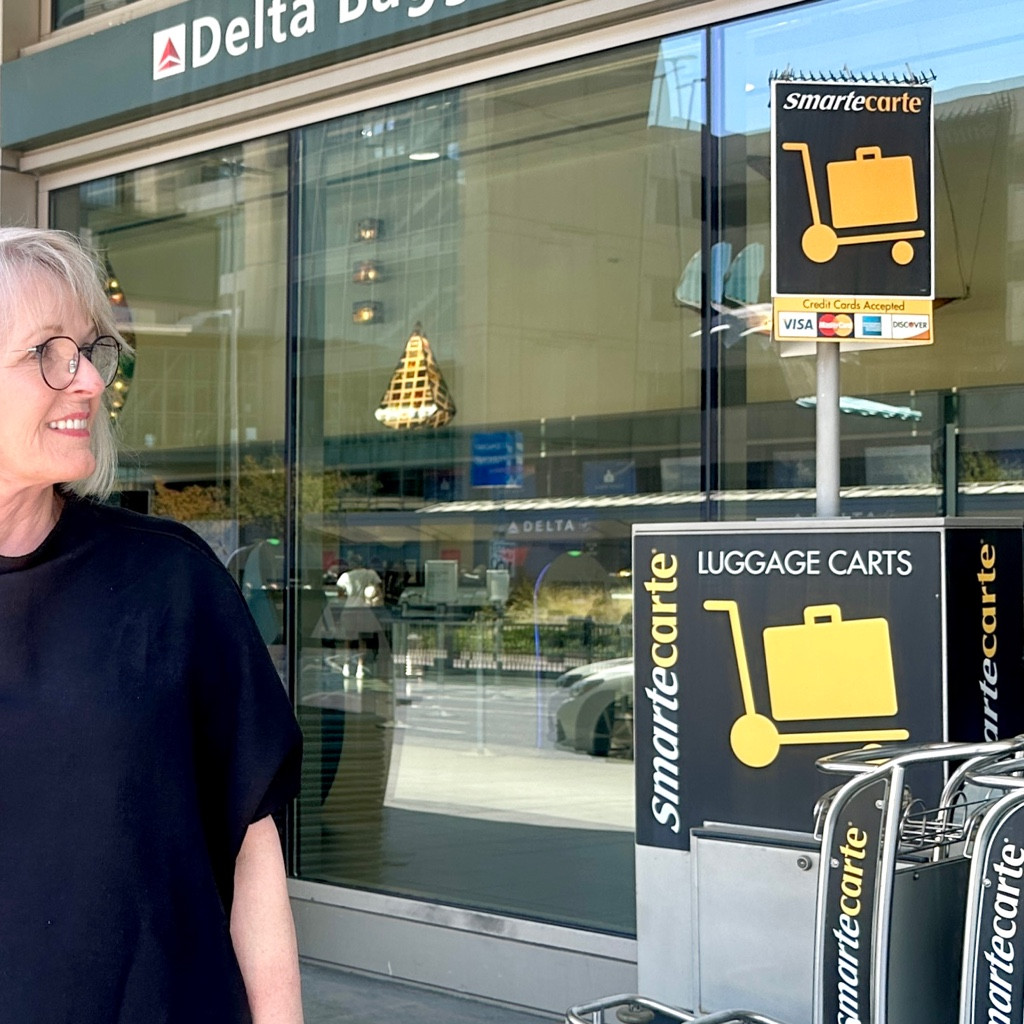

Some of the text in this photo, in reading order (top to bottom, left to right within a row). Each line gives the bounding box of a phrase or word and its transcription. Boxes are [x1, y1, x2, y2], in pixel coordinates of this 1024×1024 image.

[192, 0, 316, 68] Delta
[783, 91, 922, 113] smartecarte
[803, 299, 905, 312] Credit Cards Accepted
[784, 318, 814, 330] VISA
[893, 321, 927, 329] DISCOVER
[523, 520, 575, 533] DELTA
[698, 549, 913, 576] LUGGAGE CARTS
[977, 543, 998, 743] artecarte
[644, 552, 680, 833] smartecarte
